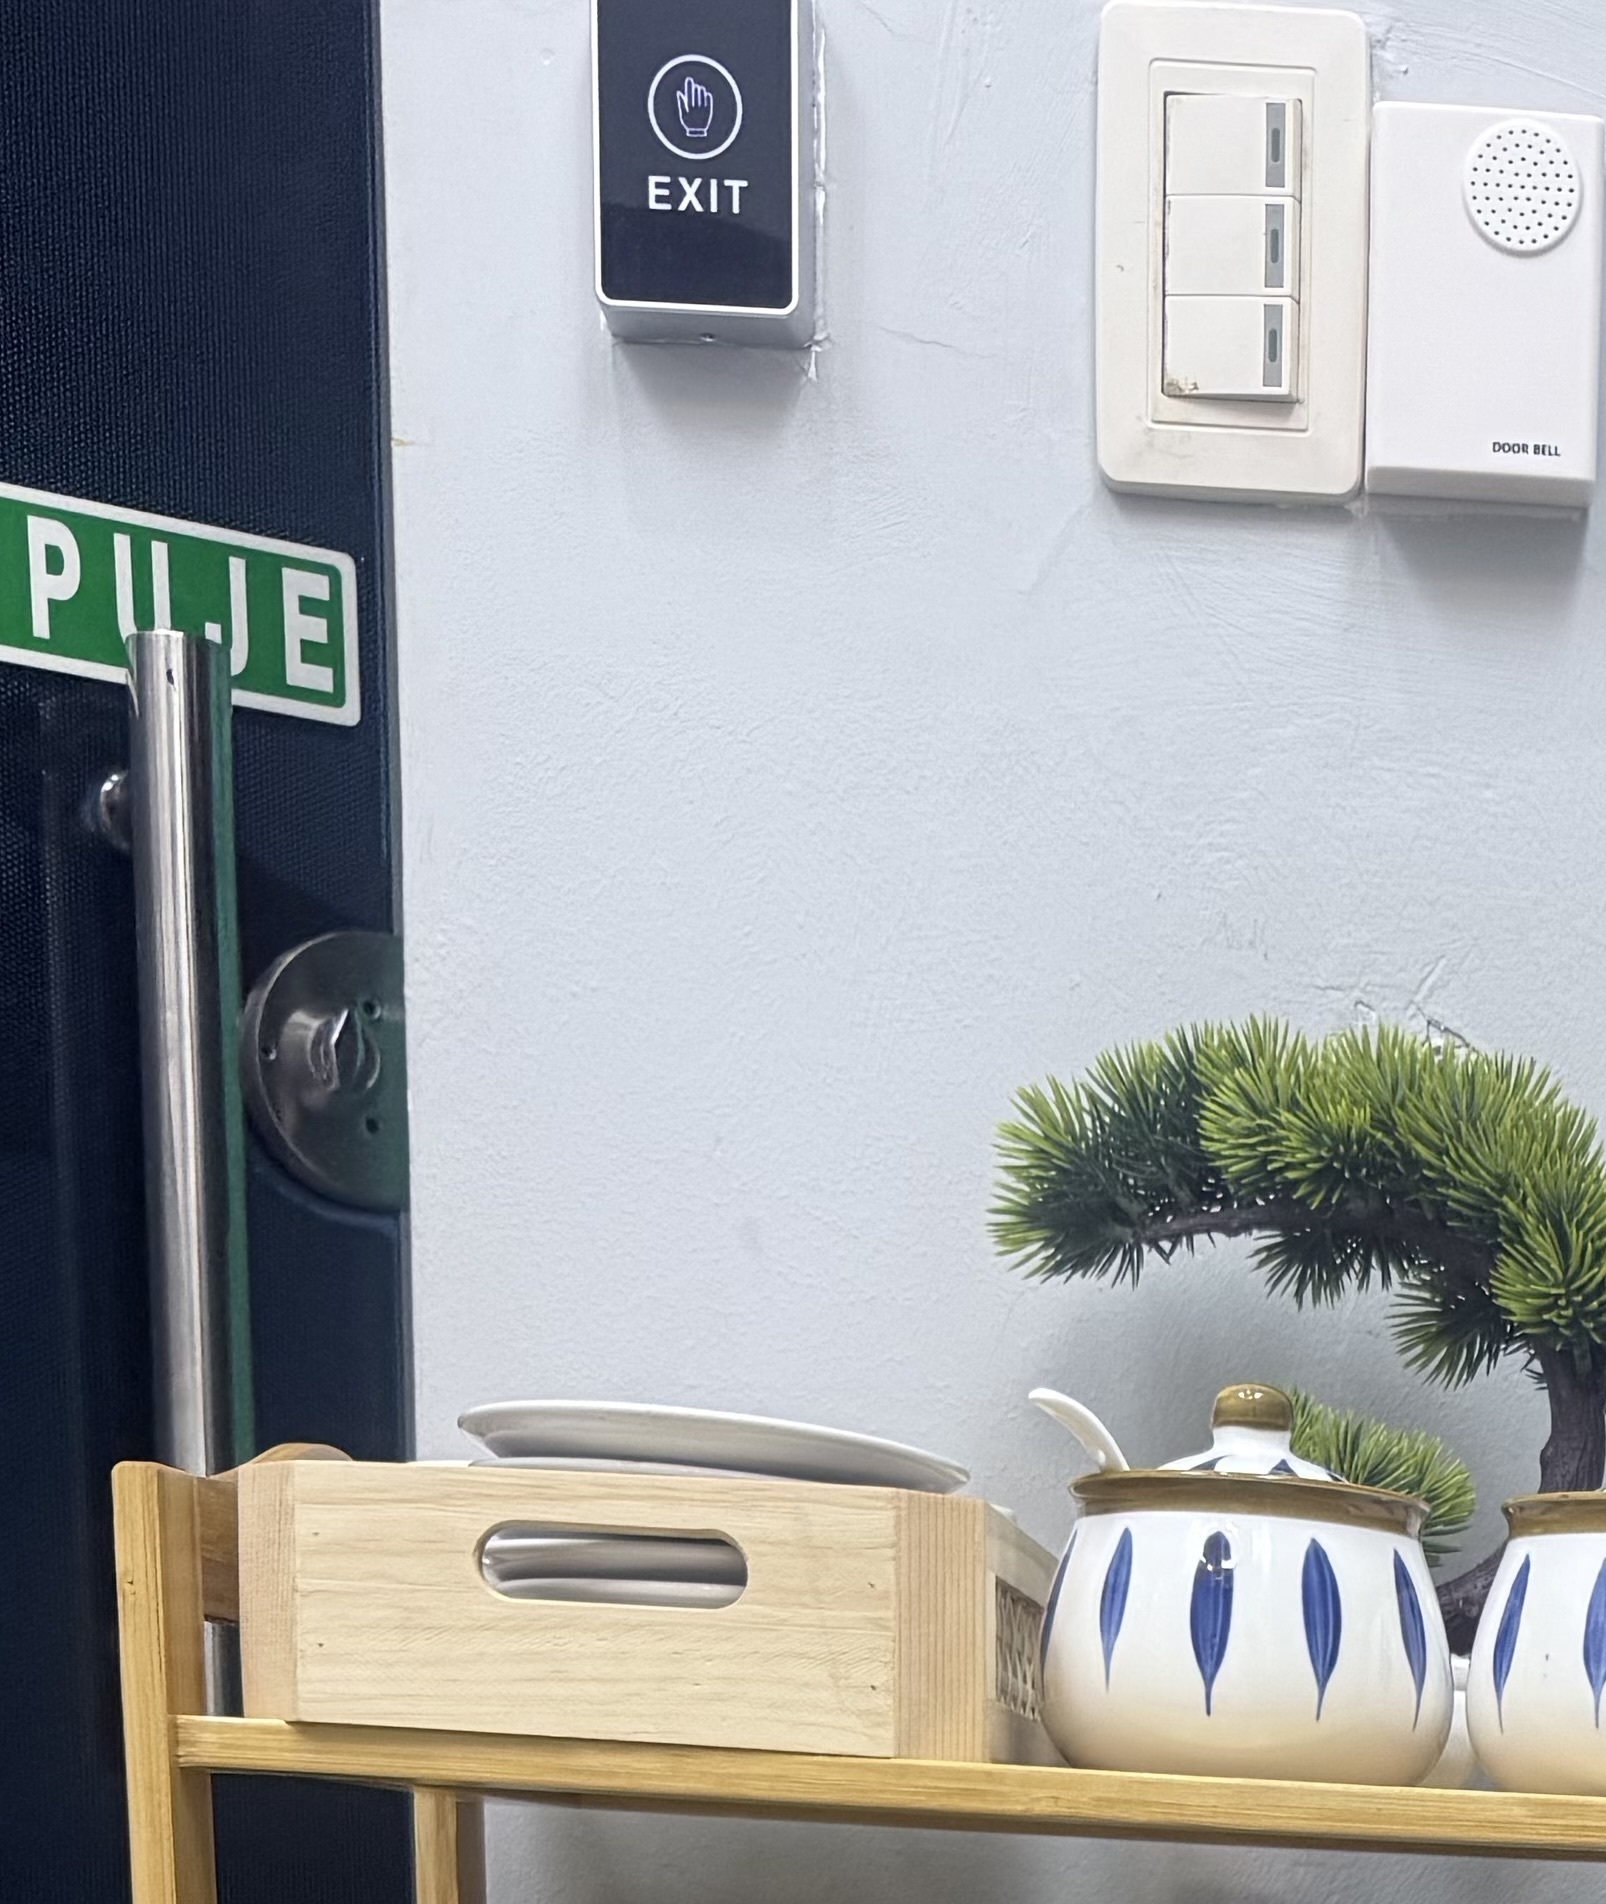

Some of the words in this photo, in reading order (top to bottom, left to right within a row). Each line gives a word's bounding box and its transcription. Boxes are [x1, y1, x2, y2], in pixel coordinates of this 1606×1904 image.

[647, 175, 749, 215] EXIT
[1492, 441, 1529, 455] DOOR
[1533, 443, 1561, 457] BELL
